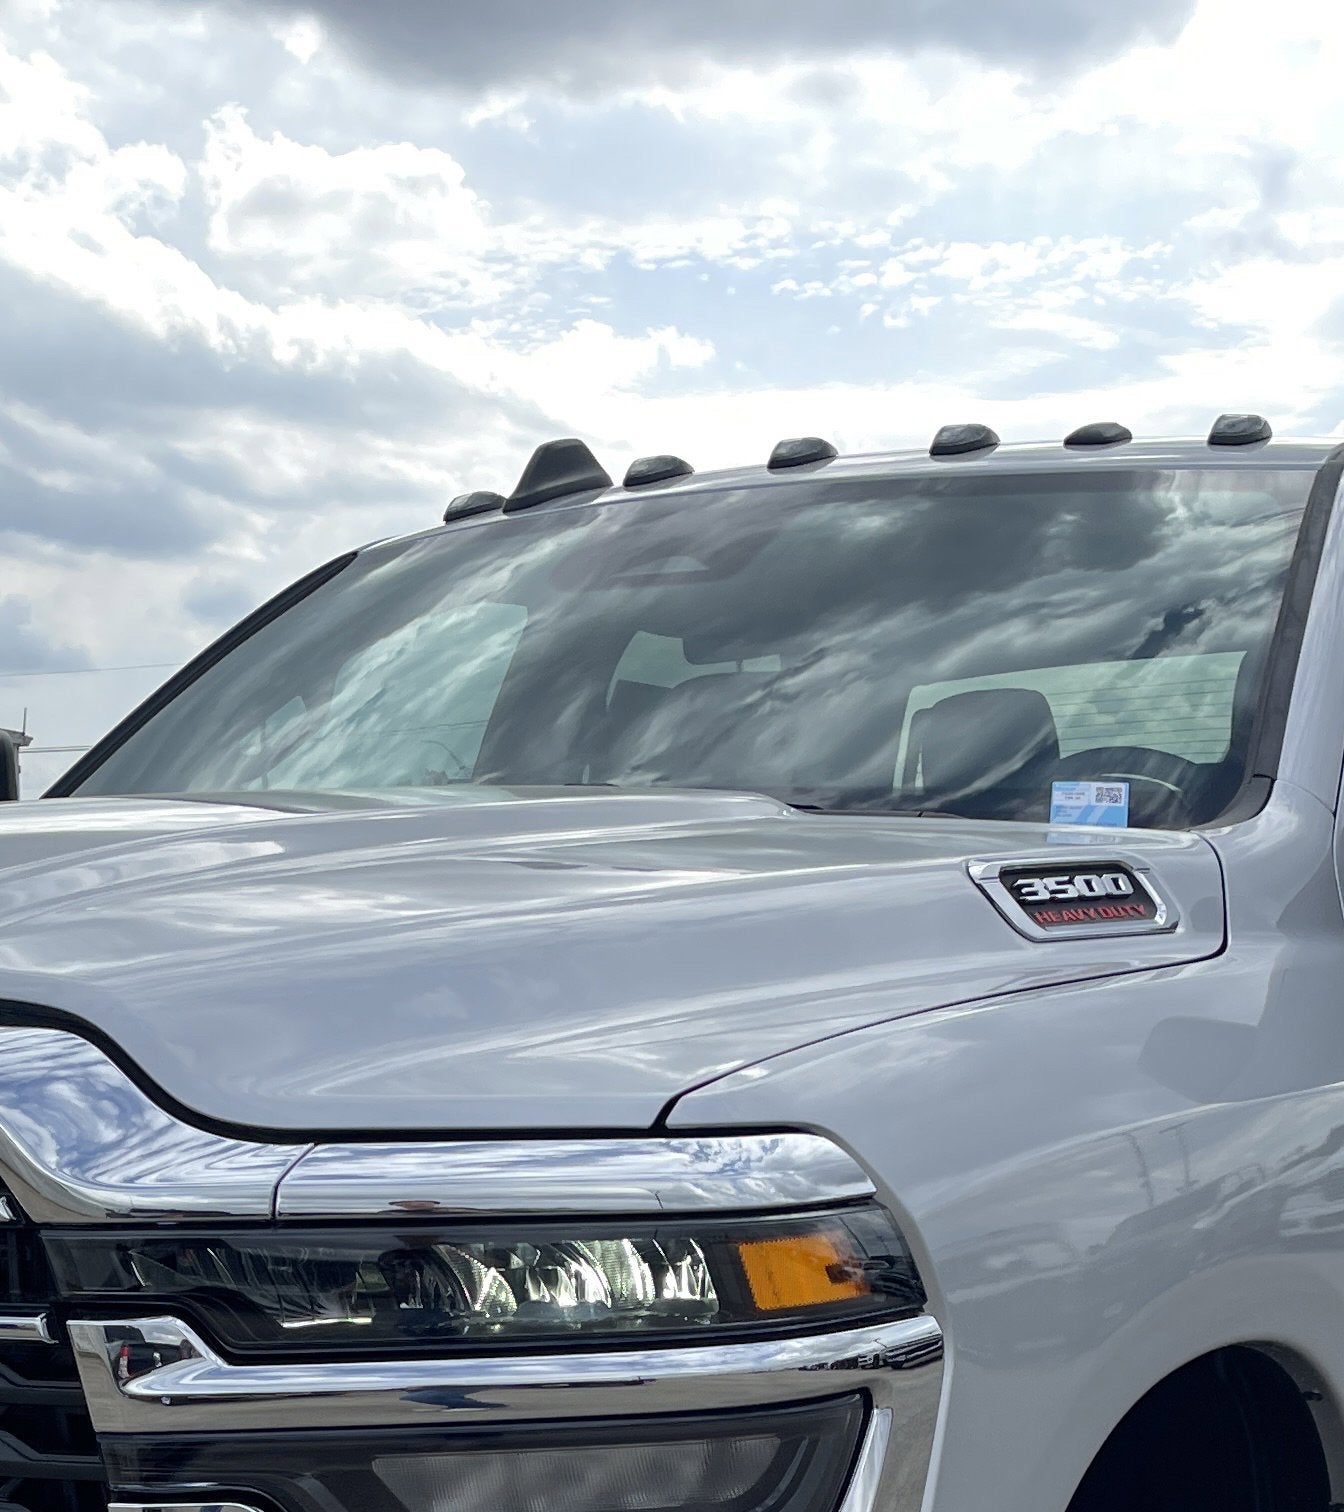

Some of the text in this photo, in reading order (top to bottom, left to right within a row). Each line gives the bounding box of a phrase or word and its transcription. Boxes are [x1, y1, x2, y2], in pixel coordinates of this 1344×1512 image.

[1013, 873, 1134, 900] 3500
[1035, 904, 1146, 923] HEAVY DUTY
